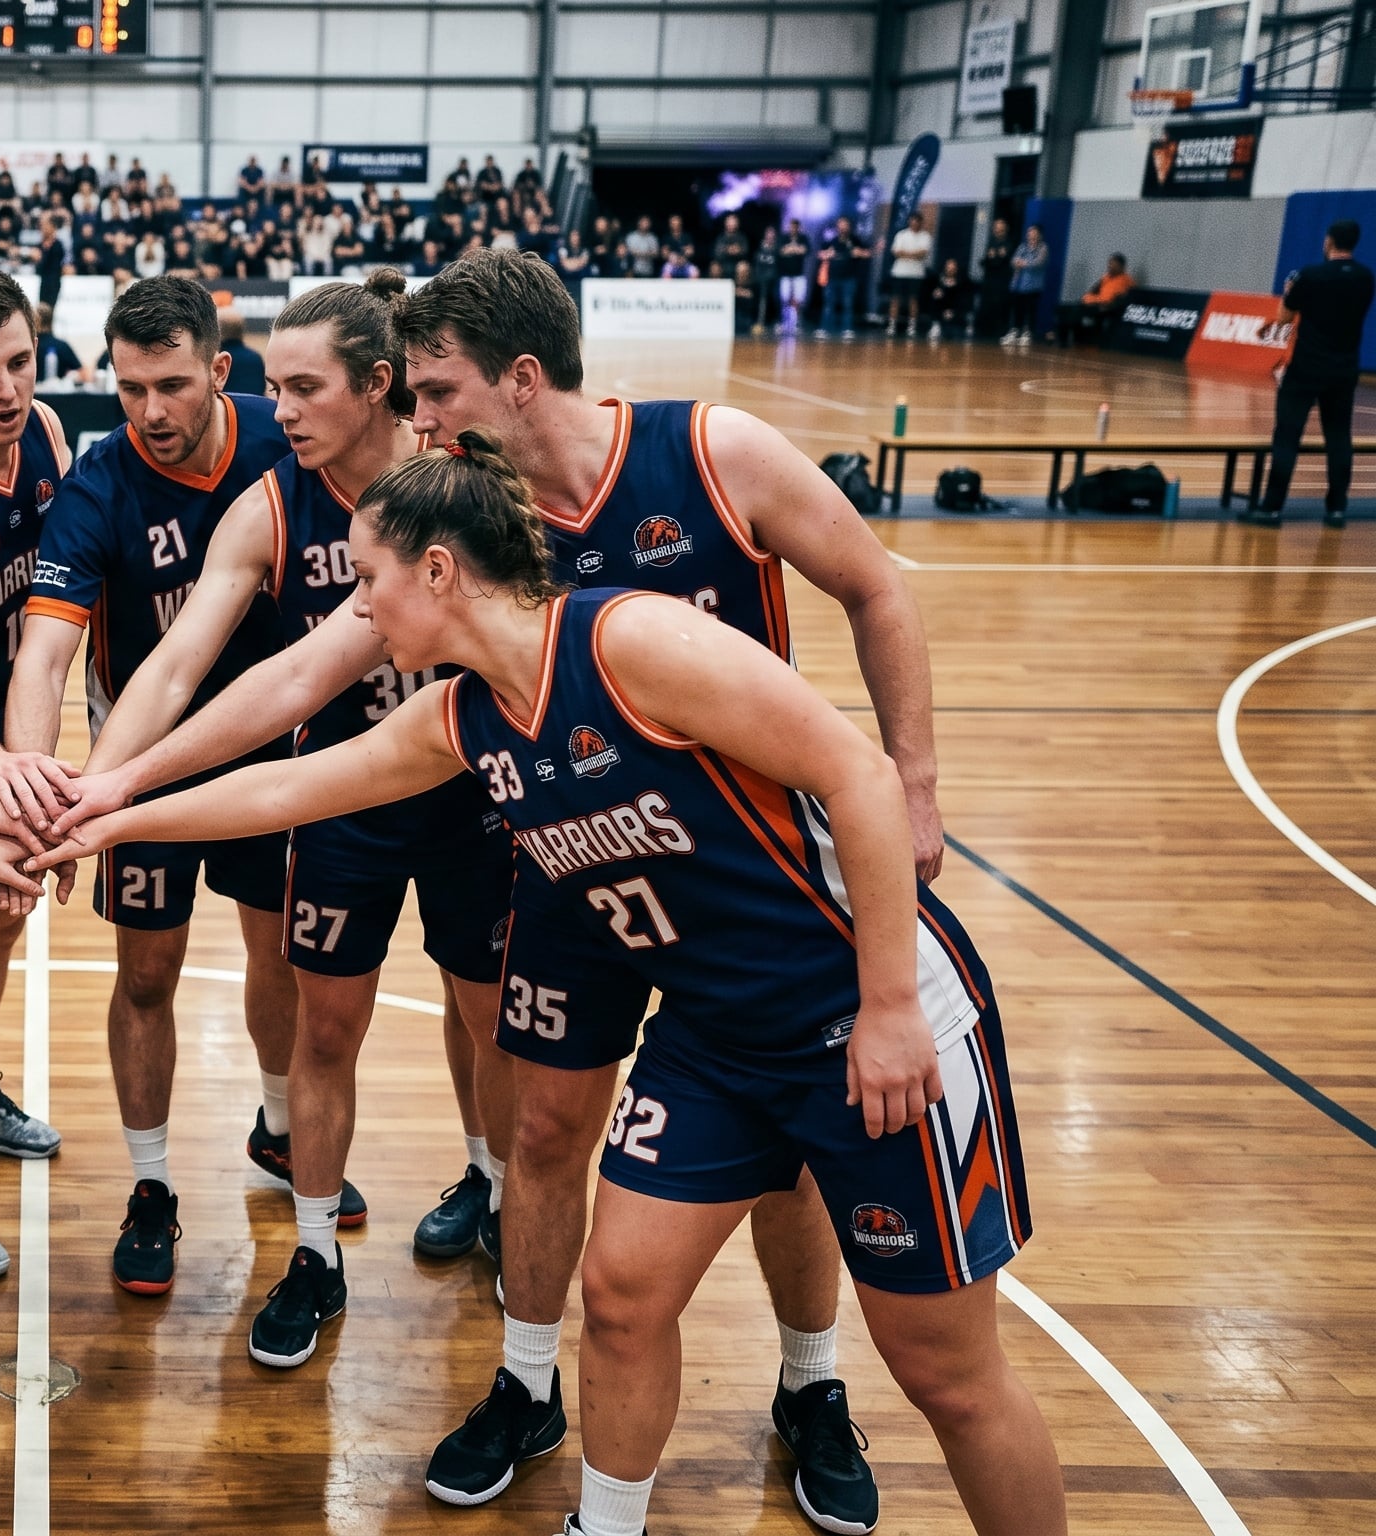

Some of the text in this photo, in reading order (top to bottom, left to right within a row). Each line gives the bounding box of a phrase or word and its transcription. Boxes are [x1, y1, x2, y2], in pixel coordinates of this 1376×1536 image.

[146, 517, 189, 569] 21
[302, 540, 357, 588] 30
[478, 750, 524, 803] 33
[121, 865, 167, 910] 21
[585, 876, 680, 950] 27
[292, 899, 350, 954] 27
[503, 975, 570, 1042] 35
[853, 1229, 916, 1247] WARRIORS
